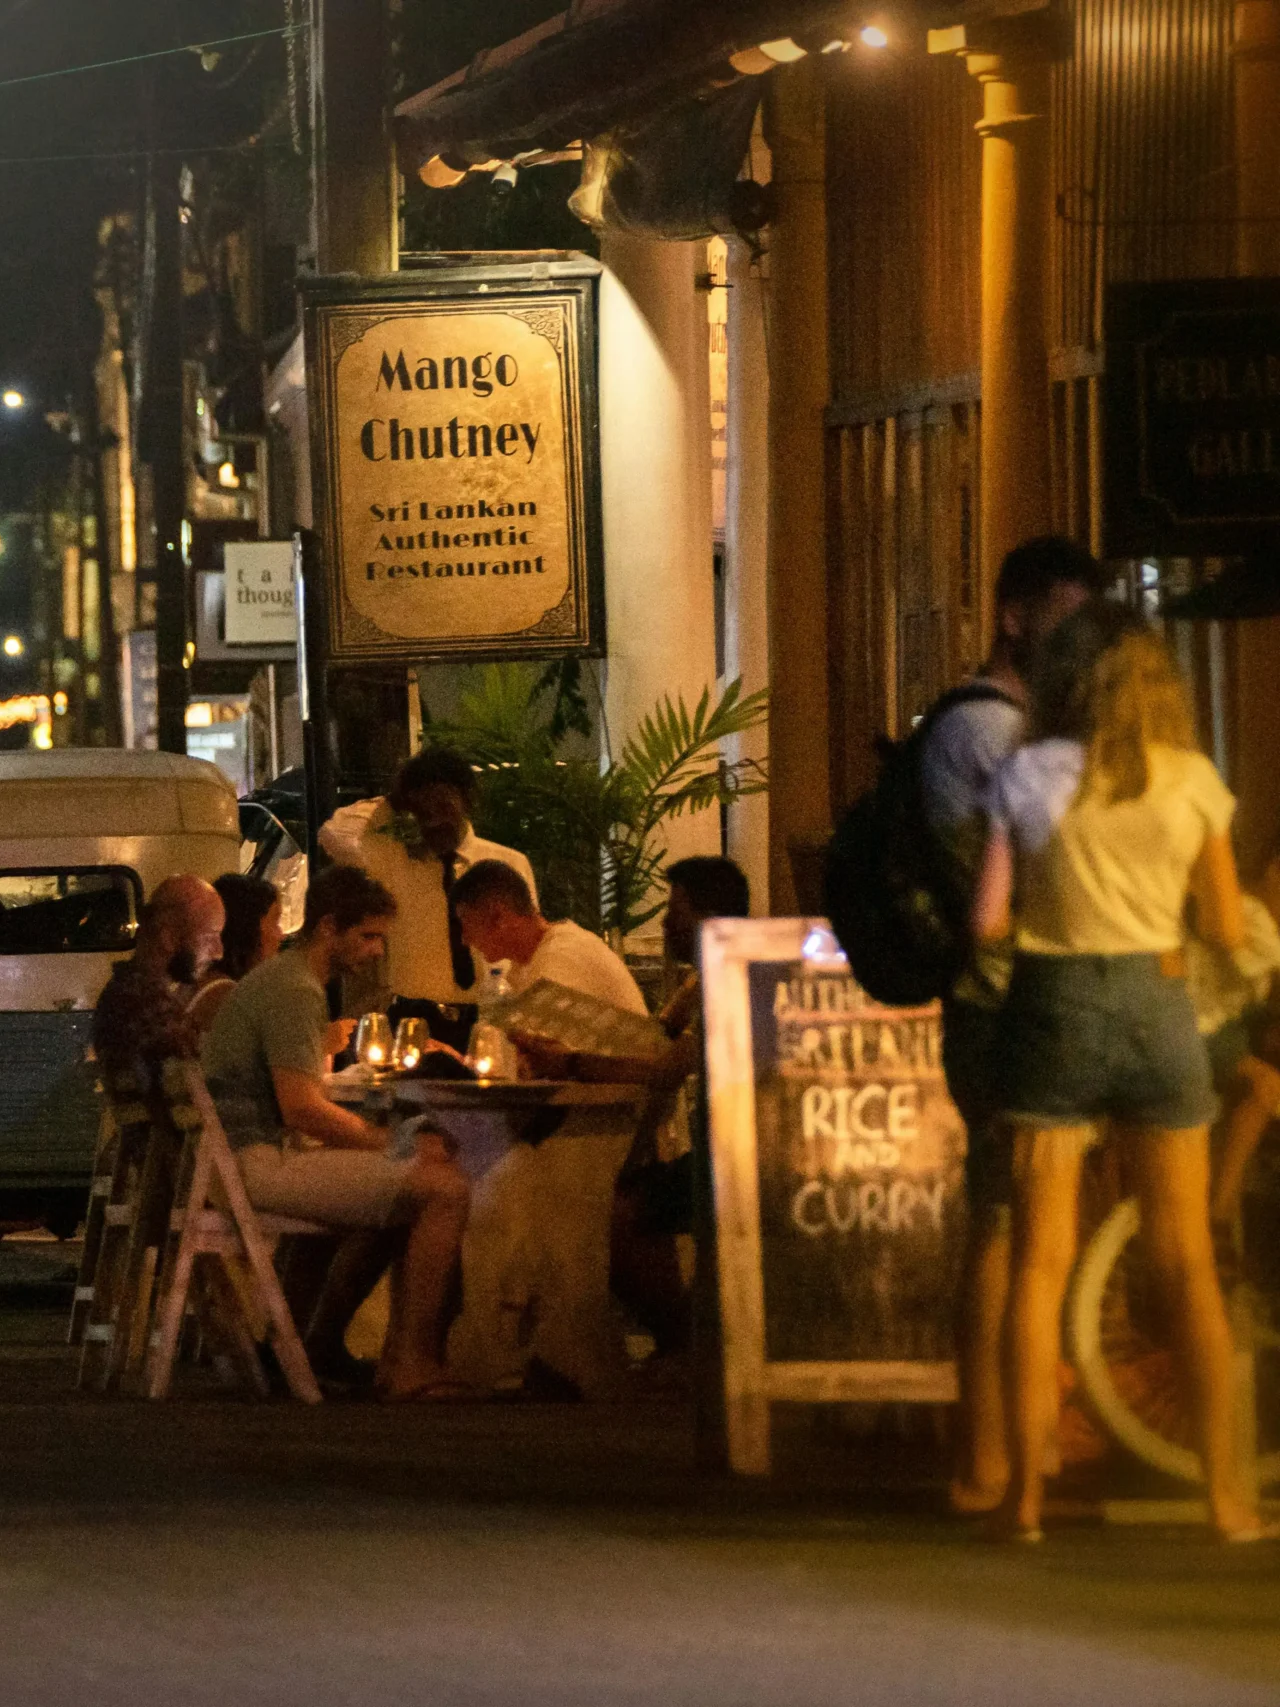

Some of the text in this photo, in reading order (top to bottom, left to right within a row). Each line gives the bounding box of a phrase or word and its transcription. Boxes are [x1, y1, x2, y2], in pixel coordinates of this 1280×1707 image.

[376, 349, 519, 398] Mango
[360, 416, 542, 465] Chutney
[369, 498, 538, 523] Sri Lankan
[374, 525, 535, 551] Authentic
[365, 555, 548, 581] Restaurant
[802, 1082, 919, 1140] RICE
[834, 1142, 901, 1173] AND
[791, 1180, 946, 1236] CURRY
